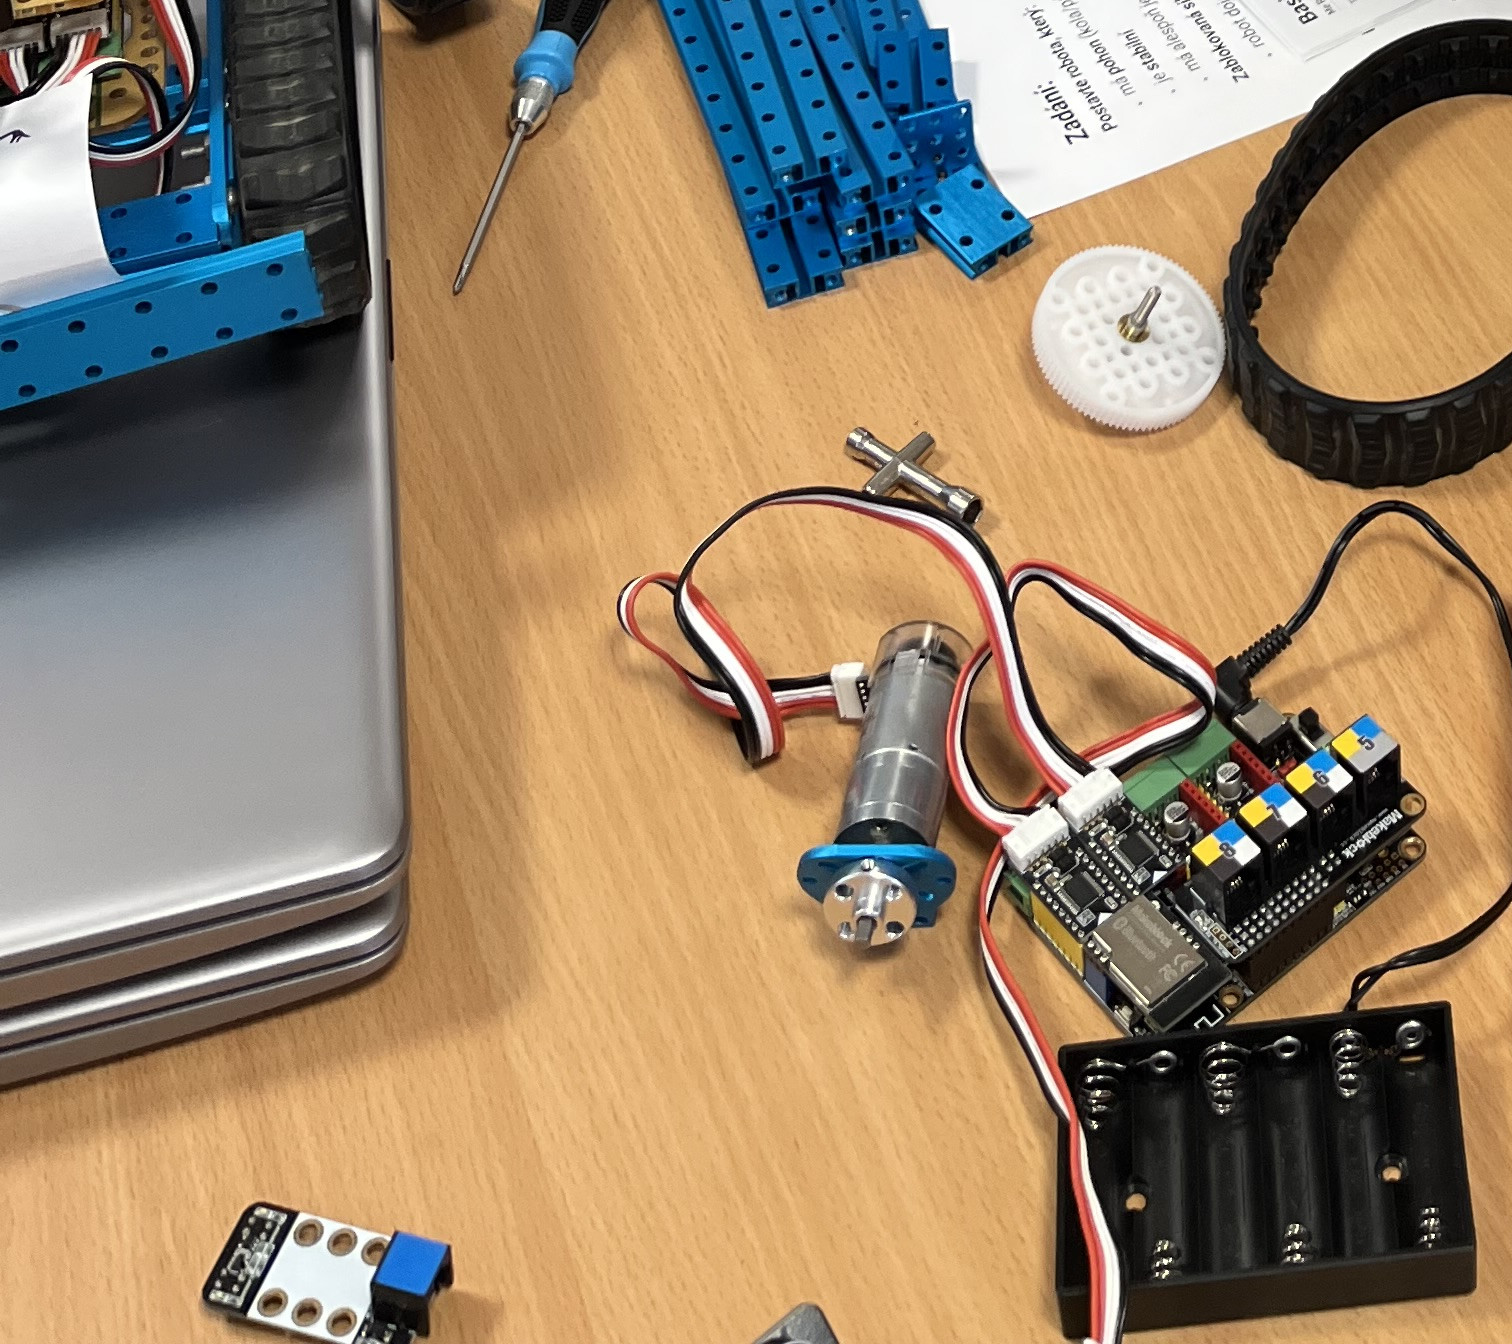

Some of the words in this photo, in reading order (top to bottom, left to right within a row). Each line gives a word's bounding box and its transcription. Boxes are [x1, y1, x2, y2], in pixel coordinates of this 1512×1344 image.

[1025, 8, 1054, 39] který:
[1144, 8, 1186, 50] alespoň
[1234, 18, 1264, 48] robot
[1050, 38, 1082, 78] robota,
[1090, 39, 1125, 75] pohon
[1119, 29, 1159, 70] stabilní
[1177, 52, 1200, 71] má
[1188, 11, 1249, 82] Zablokovaná
[1113, 76, 1136, 96] má
[1154, 72, 1173, 83] je
[1034, 81, 1089, 144] Zadání:
[1076, 79, 1117, 131] Postavte
[1357, 735, 1375, 752] 5
[1313, 768, 1329, 787] 6
[1266, 803, 1282, 821] 7
[1220, 841, 1236, 859] 8
[1339, 809, 1403, 861] Makeblock
